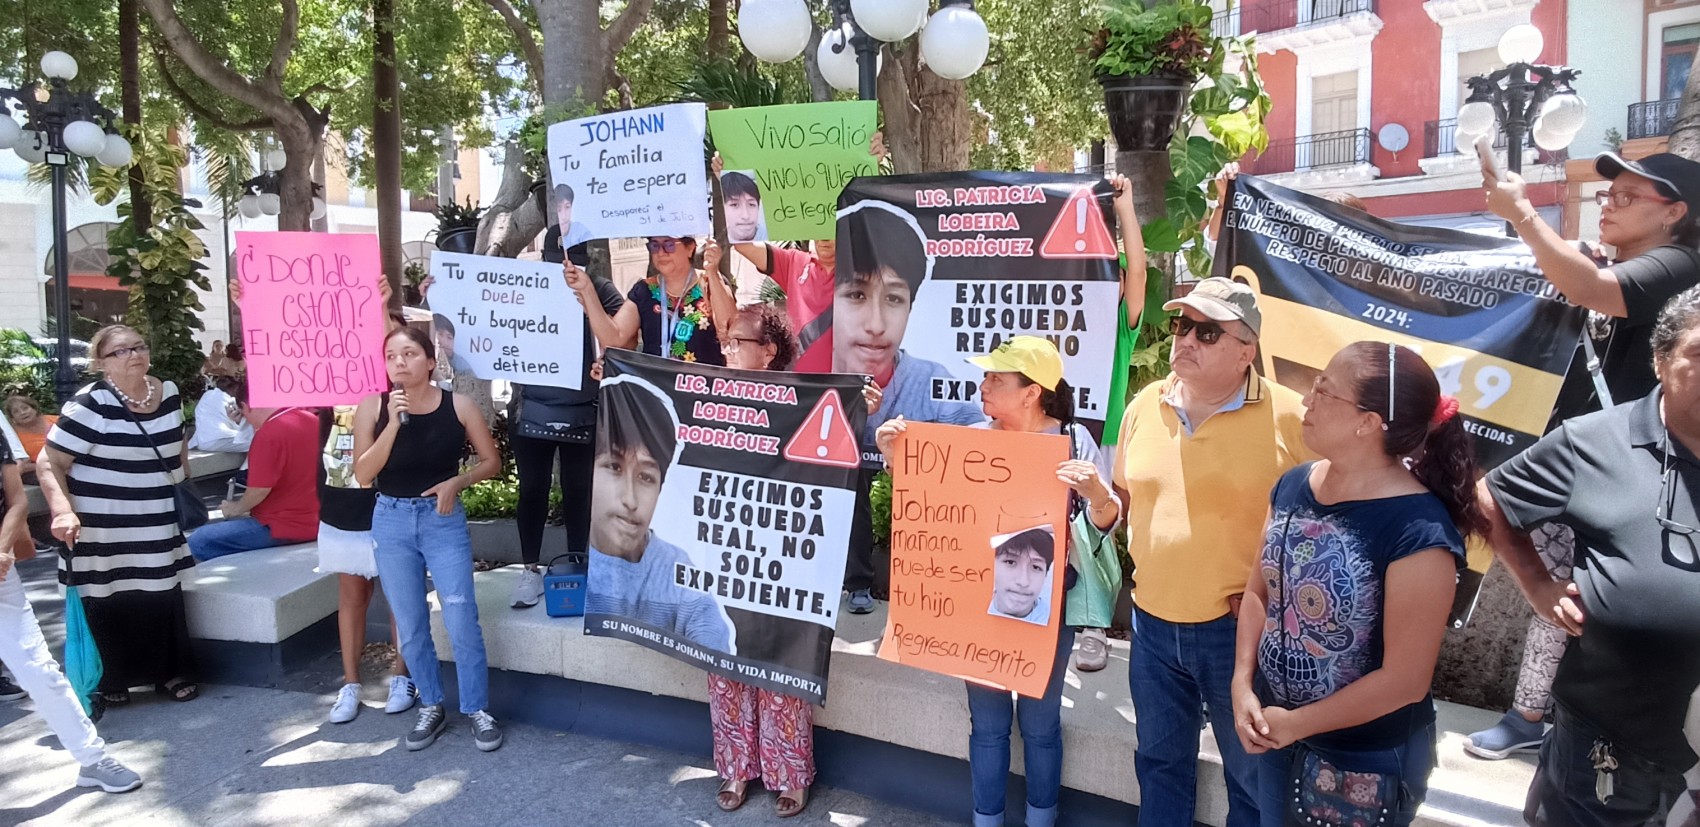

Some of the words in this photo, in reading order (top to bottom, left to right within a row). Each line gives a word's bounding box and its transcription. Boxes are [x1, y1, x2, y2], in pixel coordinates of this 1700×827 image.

[580, 112, 665, 147] JOHANN
[560, 155, 580, 173] Tu
[599, 145, 663, 170] familia
[586, 177, 608, 195] te
[624, 173, 686, 195] espera
[799, 162, 816, 189] lo
[773, 195, 797, 222] de
[800, 201, 837, 226] regre
[916, 189, 951, 208] LIC.
[954, 185, 1046, 207] PATRICIA
[1232, 191, 1254, 211] EN
[1256, 198, 1338, 233] VERACRUZ
[938, 212, 1020, 232] LOBEIRA
[926, 234, 1034, 257] RODRÍGUEZ
[1238, 212, 1301, 244] NÚMERO
[1304, 230, 1328, 251] DE
[1329, 235, 1420, 271] PERSONAS
[442, 262, 464, 282] Tu
[477, 270, 549, 289] ausencia
[1266, 240, 1349, 275] RESPECTO
[1352, 262, 1373, 282] AL
[1420, 277, 1499, 310] PASADO
[282, 286, 372, 328] estan?
[481, 290, 525, 306] Duele
[955, 283, 1084, 306] EXIGIMOS
[458, 310, 476, 327] tu
[489, 313, 559, 339] buqueda
[951, 304, 1087, 332] BÚSQUEDA
[1362, 303, 1413, 329] 2024:
[247, 329, 270, 357] El
[280, 328, 361, 359] estado
[469, 336, 493, 354] NO
[502, 345, 520, 357] se
[273, 364, 294, 394] lo
[299, 355, 381, 395] sabe!!
[493, 357, 560, 375] detiene
[675, 373, 709, 395] LIC.
[713, 378, 798, 405] PATRICIA
[692, 401, 769, 428] LOBEIRA
[676, 424, 780, 455] RODRÍGUEZ
[1462, 420, 1515, 445] RECIDAS
[904, 437, 952, 484] HOY
[963, 450, 1012, 483] es
[699, 472, 823, 511] EXIGIMOS
[893, 489, 977, 525] Johann
[693, 493, 825, 537] BÚSQUEDA
[697, 521, 768, 558] REAL,
[781, 538, 817, 561] NO
[720, 551, 783, 581] SOLO
[950, 566, 991, 583] ser
[675, 564, 832, 619] EXPEDIENTE.
[893, 584, 915, 607] tu
[920, 583, 954, 618] hijo
[602, 620, 618, 631] SU
[620, 623, 662, 645] NOMBRE
[662, 634, 675, 648] ES
[674, 641, 718, 667] JOHANN,
[720, 657, 735, 671] SU
[737, 663, 768, 680] VIDA
[770, 670, 823, 696] IMPORTA
[891, 623, 960, 657] Regresa
[964, 642, 1036, 678] negrito
